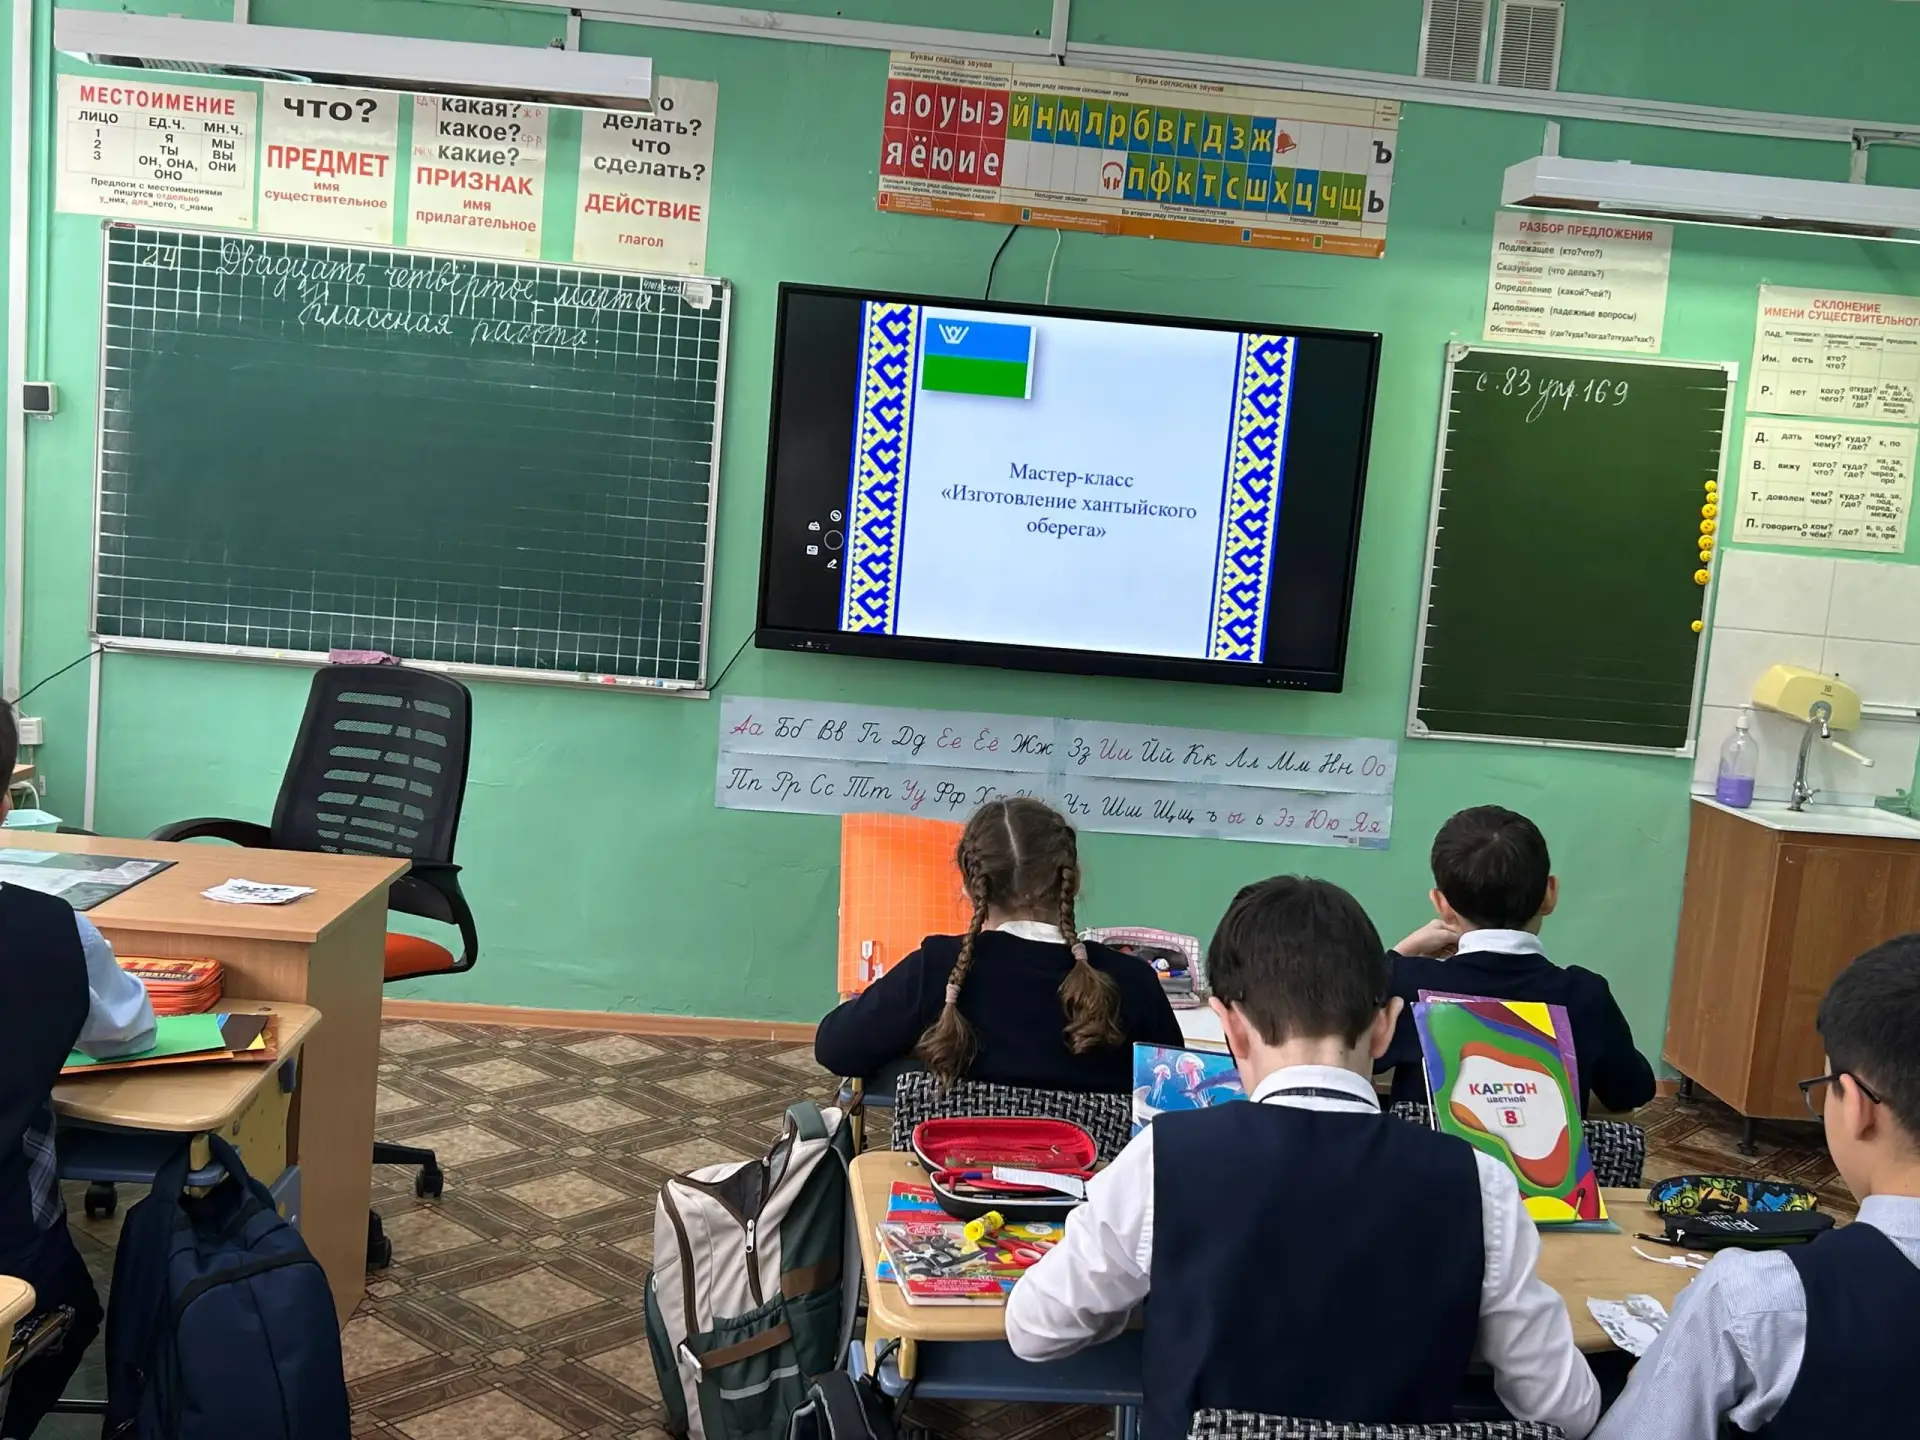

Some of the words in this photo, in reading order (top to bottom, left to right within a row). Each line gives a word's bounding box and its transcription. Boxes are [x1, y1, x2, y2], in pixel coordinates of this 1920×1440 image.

[910, 52, 934, 62] Буквы
[936, 56, 965, 66] гласных
[968, 61, 992, 69] звуков
[1135, 75, 1158, 86] Буквы
[1160, 79, 1197, 91] согласных
[1199, 84, 1224, 93] звуков
[80, 85, 235, 116] МЕСТОИМЕНИЕ
[283, 98, 377, 123] что?
[441, 97, 522, 118] какая?
[78, 110, 118, 124] ЛИЦО
[149, 117, 185, 131] ЕД.Ч.
[204, 122, 243, 136] МН.Ч.
[440, 120, 521, 142] какое?
[603, 113, 703, 137] делать?
[96, 128, 101, 138] 1
[165, 133, 174, 144] Я
[211, 139, 235, 150] МЫ
[631, 138, 671, 155] что
[93, 139, 102, 149] 2
[160, 145, 179, 156] ТЫ
[212, 150, 233, 161] ВЫ
[438, 145, 519, 167] какие?
[93, 150, 101, 160] 3
[138, 156, 162, 168] ОН,
[167, 158, 198, 172] ОНА,
[208, 161, 236, 173] ОНИ
[267, 145, 389, 178] ПРЕДМЕТ
[593, 155, 705, 181] сделать?
[154, 169, 183, 181] ОНО
[416, 166, 533, 195] ПРИЗНАК
[91, 177, 136, 189] Предлоги
[147, 184, 223, 197] местоимениями
[114, 188, 153, 198] пишутся
[156, 192, 200, 203] отдельно
[313, 181, 339, 192] имя
[264, 188, 388, 209] существительное
[463, 199, 491, 212] имя
[585, 193, 701, 222] ДЕЙСТВИЕ
[416, 210, 537, 232] прилагательное
[1519, 222, 1564, 235] РАЗБОР
[1567, 225, 1653, 241] ПРЕДЛОЖЕНИЯ
[618, 232, 664, 248] глагол
[1498, 242, 1554, 255] Подлежащее
[142, 245, 179, 271] 24
[216, 241, 366, 298] Двадцать
[385, 261, 533, 315] четвёртое
[1497, 262, 1543, 274] Сказуемое
[1548, 266, 1565, 276] (что
[1567, 268, 1604, 279] делать?)
[1495, 282, 1552, 294] Определение
[298, 280, 453, 334] Классная
[1492, 302, 1545, 314] Дополнение
[1550, 306, 1595, 318] (падежные
[1598, 311, 1637, 322] вопросы)
[1764, 307, 1805, 319] ИМЕНИ
[1808, 310, 1920, 327] СУЩЕСТВИТЕЛЬНОГ
[1813, 299, 1881, 314] СКЛОНЕНИЕ
[1490, 324, 1546, 336] Обстоятельство
[1761, 354, 1780, 363] Им.
[1792, 356, 1814, 364] есть
[1584, 378, 1629, 406] 169
[1761, 385, 1773, 396] Р.
[1754, 431, 1769, 444] Д.
[1781, 433, 1802, 441] дать
[1009, 462, 1134, 488] Мастер-класс
[941, 484, 1077, 510] «Изготовление
[1081, 499, 1197, 519] хантыйского
[1027, 517, 1107, 539] оберега»
[731, 714, 764, 736] Аа
[774, 716, 812, 738] Бб
[817, 719, 848, 742] Вв
[857, 721, 882, 744] Гг
[891, 725, 927, 757] Дд
[936, 727, 962, 750] Ее
[973, 727, 1000, 752] Ёё
[1011, 732, 1053, 756] Жж
[1067, 737, 1091, 765] Зз
[1099, 738, 1133, 761] Ии
[1141, 737, 1174, 764] Йй
[1182, 743, 1218, 766] Кк
[1225, 747, 1259, 769] Лл
[1267, 751, 1310, 772] Мм
[1318, 753, 1353, 775] Нн
[1362, 755, 1385, 777] Оо
[726, 768, 763, 791] Пп
[772, 771, 802, 802] Рр
[810, 773, 834, 797] Сс
[843, 775, 893, 800] Тт
[901, 779, 927, 811] Уу
[933, 781, 966, 805] Фф
[1063, 792, 1091, 815] Чч
[1102, 796, 1142, 819] Шш
[1154, 799, 1195, 824] Щщ
[1206, 810, 1217, 823] ъ
[1227, 811, 1244, 824] ы
[1255, 814, 1264, 826] ь
[1274, 807, 1295, 828] Ээ
[1305, 808, 1339, 831] Юю
[1350, 811, 1381, 834] Яя
[1469, 1082, 1538, 1095] КАРТОН
[1486, 1095, 1526, 1104] ЦВЕТНОЙ
[1504, 1110, 1518, 1125] 8
